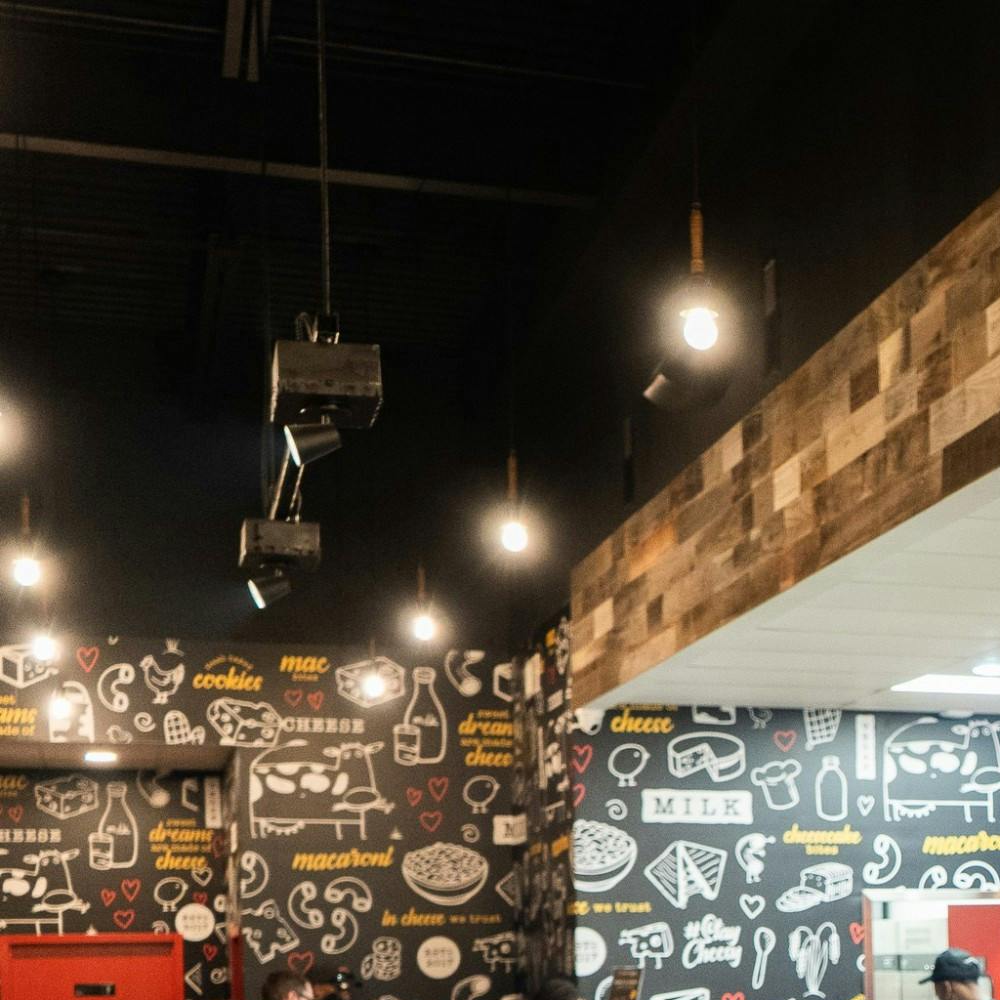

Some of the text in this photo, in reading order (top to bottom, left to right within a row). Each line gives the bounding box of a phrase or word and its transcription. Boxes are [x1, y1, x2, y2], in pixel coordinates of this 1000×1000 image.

[279, 655, 330, 673] mac
[192, 667, 263, 691] cookies
[284, 716, 365, 733] CHEESE
[610, 707, 674, 733] cheese
[654, 798, 739, 816] MILK
[155, 850, 207, 871] cheese
[292, 845, 394, 871] macaroni
[381, 908, 396, 926] in
[401, 906, 445, 926] cheese
